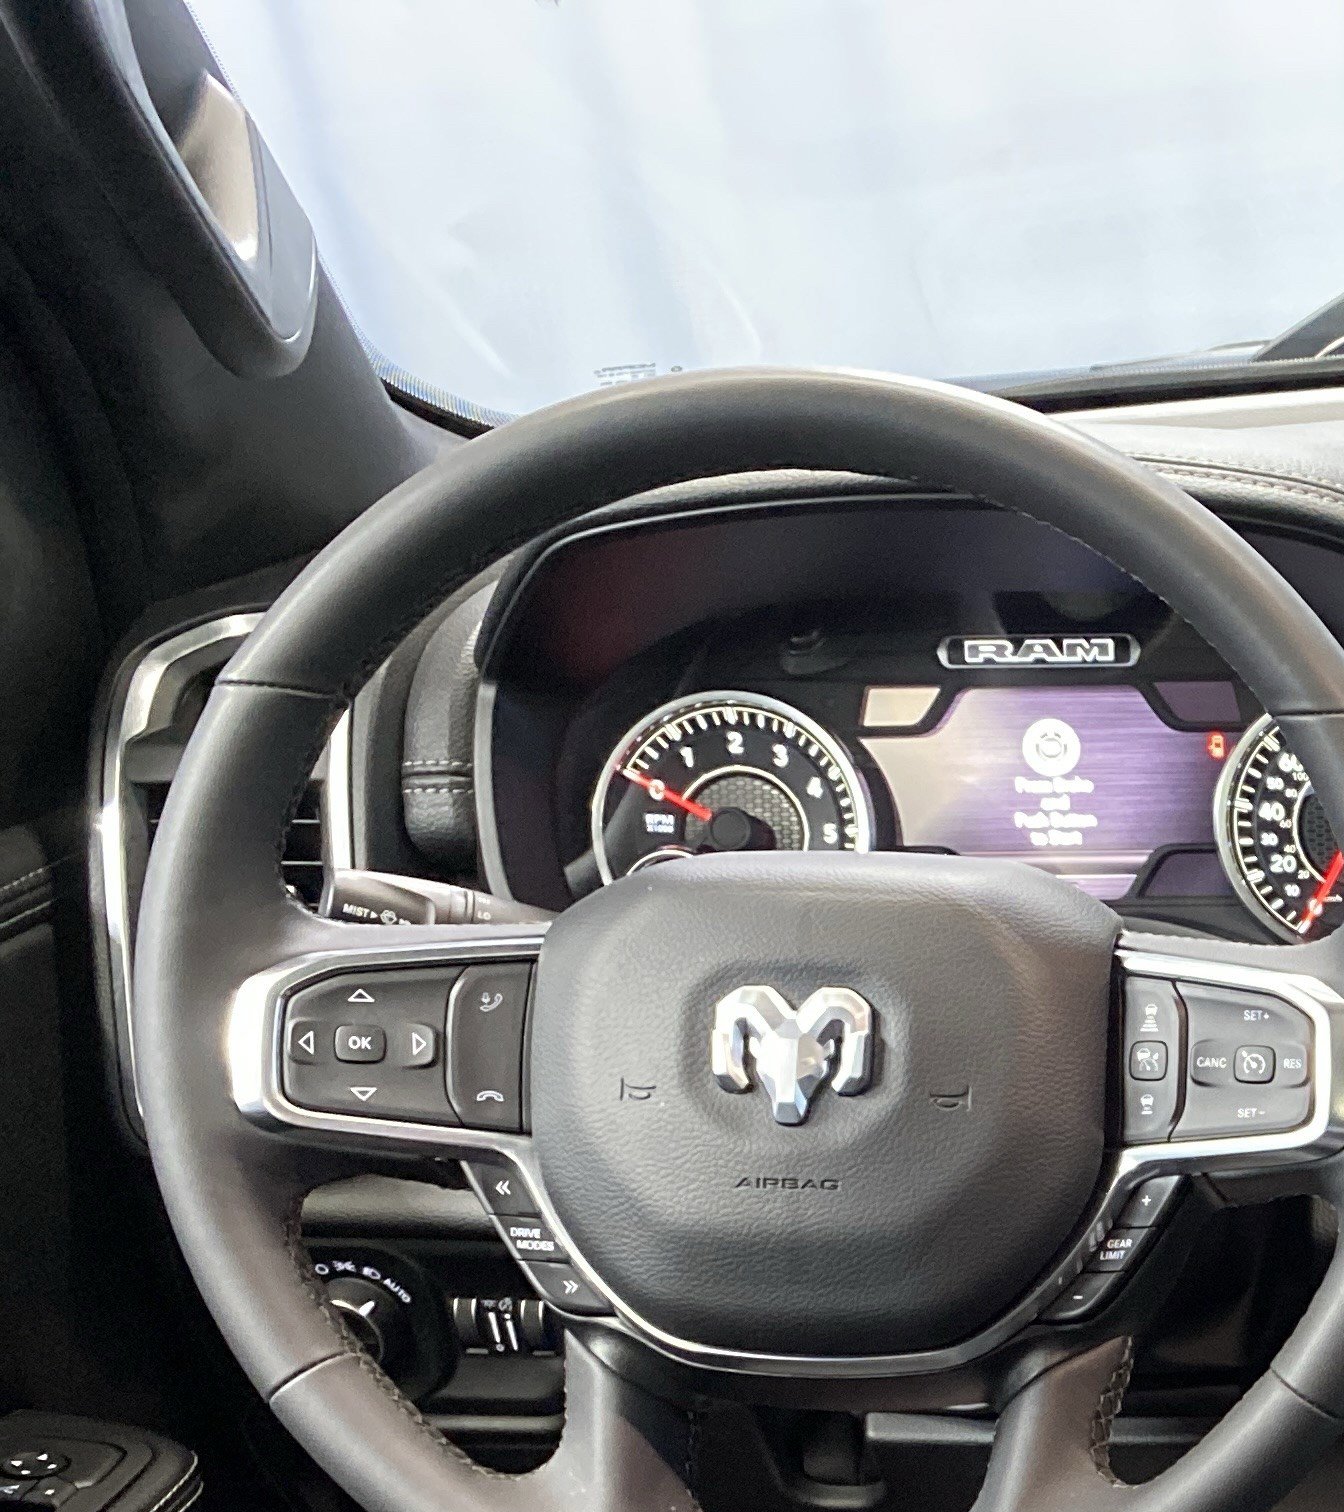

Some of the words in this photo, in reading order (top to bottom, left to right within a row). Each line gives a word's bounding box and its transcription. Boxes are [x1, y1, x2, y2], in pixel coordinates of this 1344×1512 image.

[964, 638, 1116, 664] RAM
[726, 731, 744, 755] 2
[680, 746, 695, 768] 1
[772, 743, 789, 768] 3
[807, 776, 823, 798] 4
[1258, 802, 1286, 821] 40
[823, 823, 838, 844] 5
[1270, 854, 1297, 873] 20
[1297, 869, 1310, 879] 20
[1284, 884, 1300, 897] 10
[342, 903, 370, 918] MIST
[348, 1036, 371, 1050] OK
[1196, 1057, 1227, 1069] CANC
[1283, 1058, 1302, 1069] RES
[735, 1176, 842, 1192] AIRBAG
[510, 1227, 541, 1239] DRIVE
[516, 1240, 555, 1252] MODES
[1107, 1239, 1133, 1249] GEAR
[1100, 1250, 1126, 1260] LIMIT
[383, 1278, 411, 1303] AUTO
